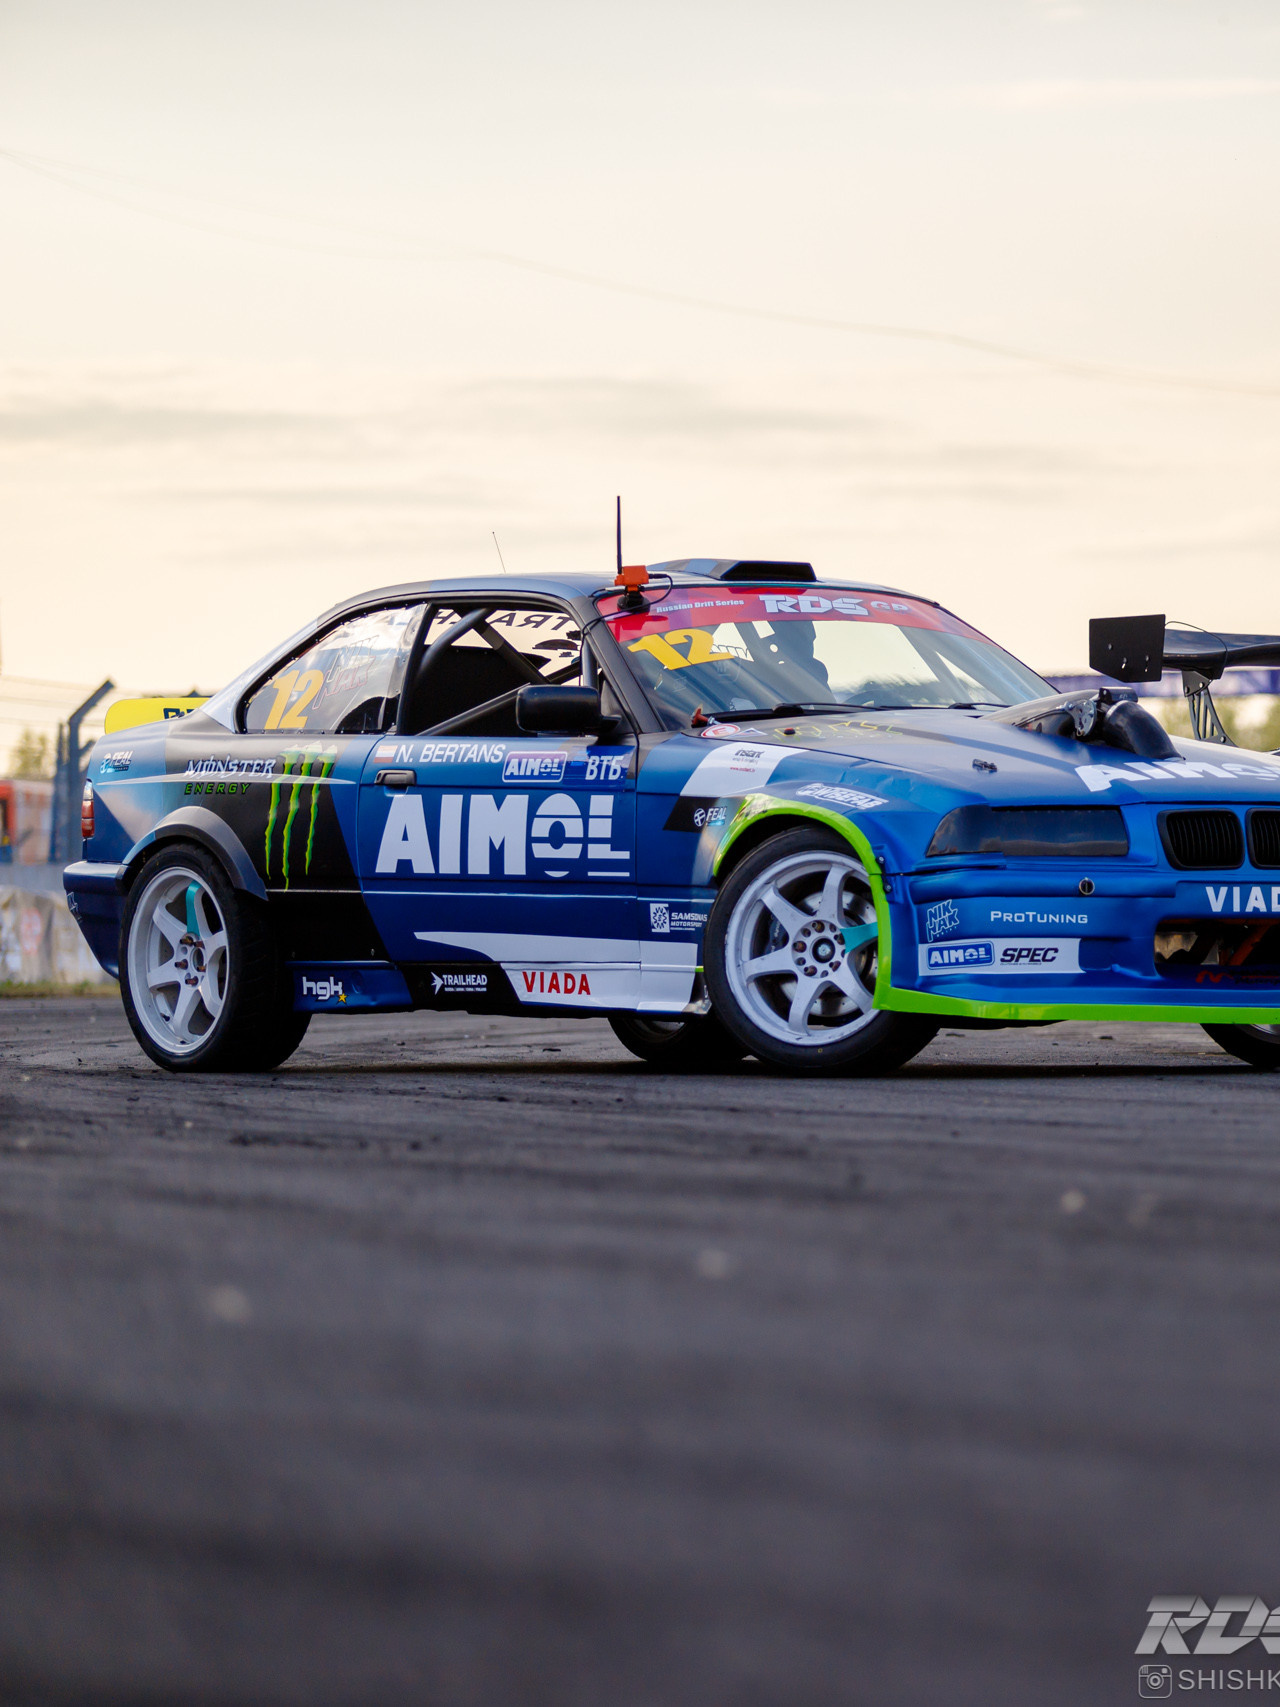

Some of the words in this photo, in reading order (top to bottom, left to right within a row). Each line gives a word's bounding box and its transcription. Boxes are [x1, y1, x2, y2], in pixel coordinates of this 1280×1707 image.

[656, 603, 693, 613] Russian
[694, 601, 714, 609] Drift
[758, 594, 869, 616] RDS
[870, 600, 909, 612] GP
[627, 628, 735, 670] 12
[265, 669, 324, 729] 12
[395, 744, 413, 763] N.
[419, 743, 506, 763] BERTANS
[184, 754, 276, 779] MONSTER
[505, 758, 561, 777] AIMOL
[585, 755, 624, 781] ВТБ
[184, 782, 251, 796] ENERGY
[705, 807, 727, 821] FEAL
[375, 792, 630, 878] AIMOL
[929, 947, 991, 965] AIMOL
[1000, 947, 1059, 963] SPEC
[302, 977, 343, 1000] hgk
[442, 974, 488, 986] TRAILHEAD
[522, 971, 591, 996] VIADA
